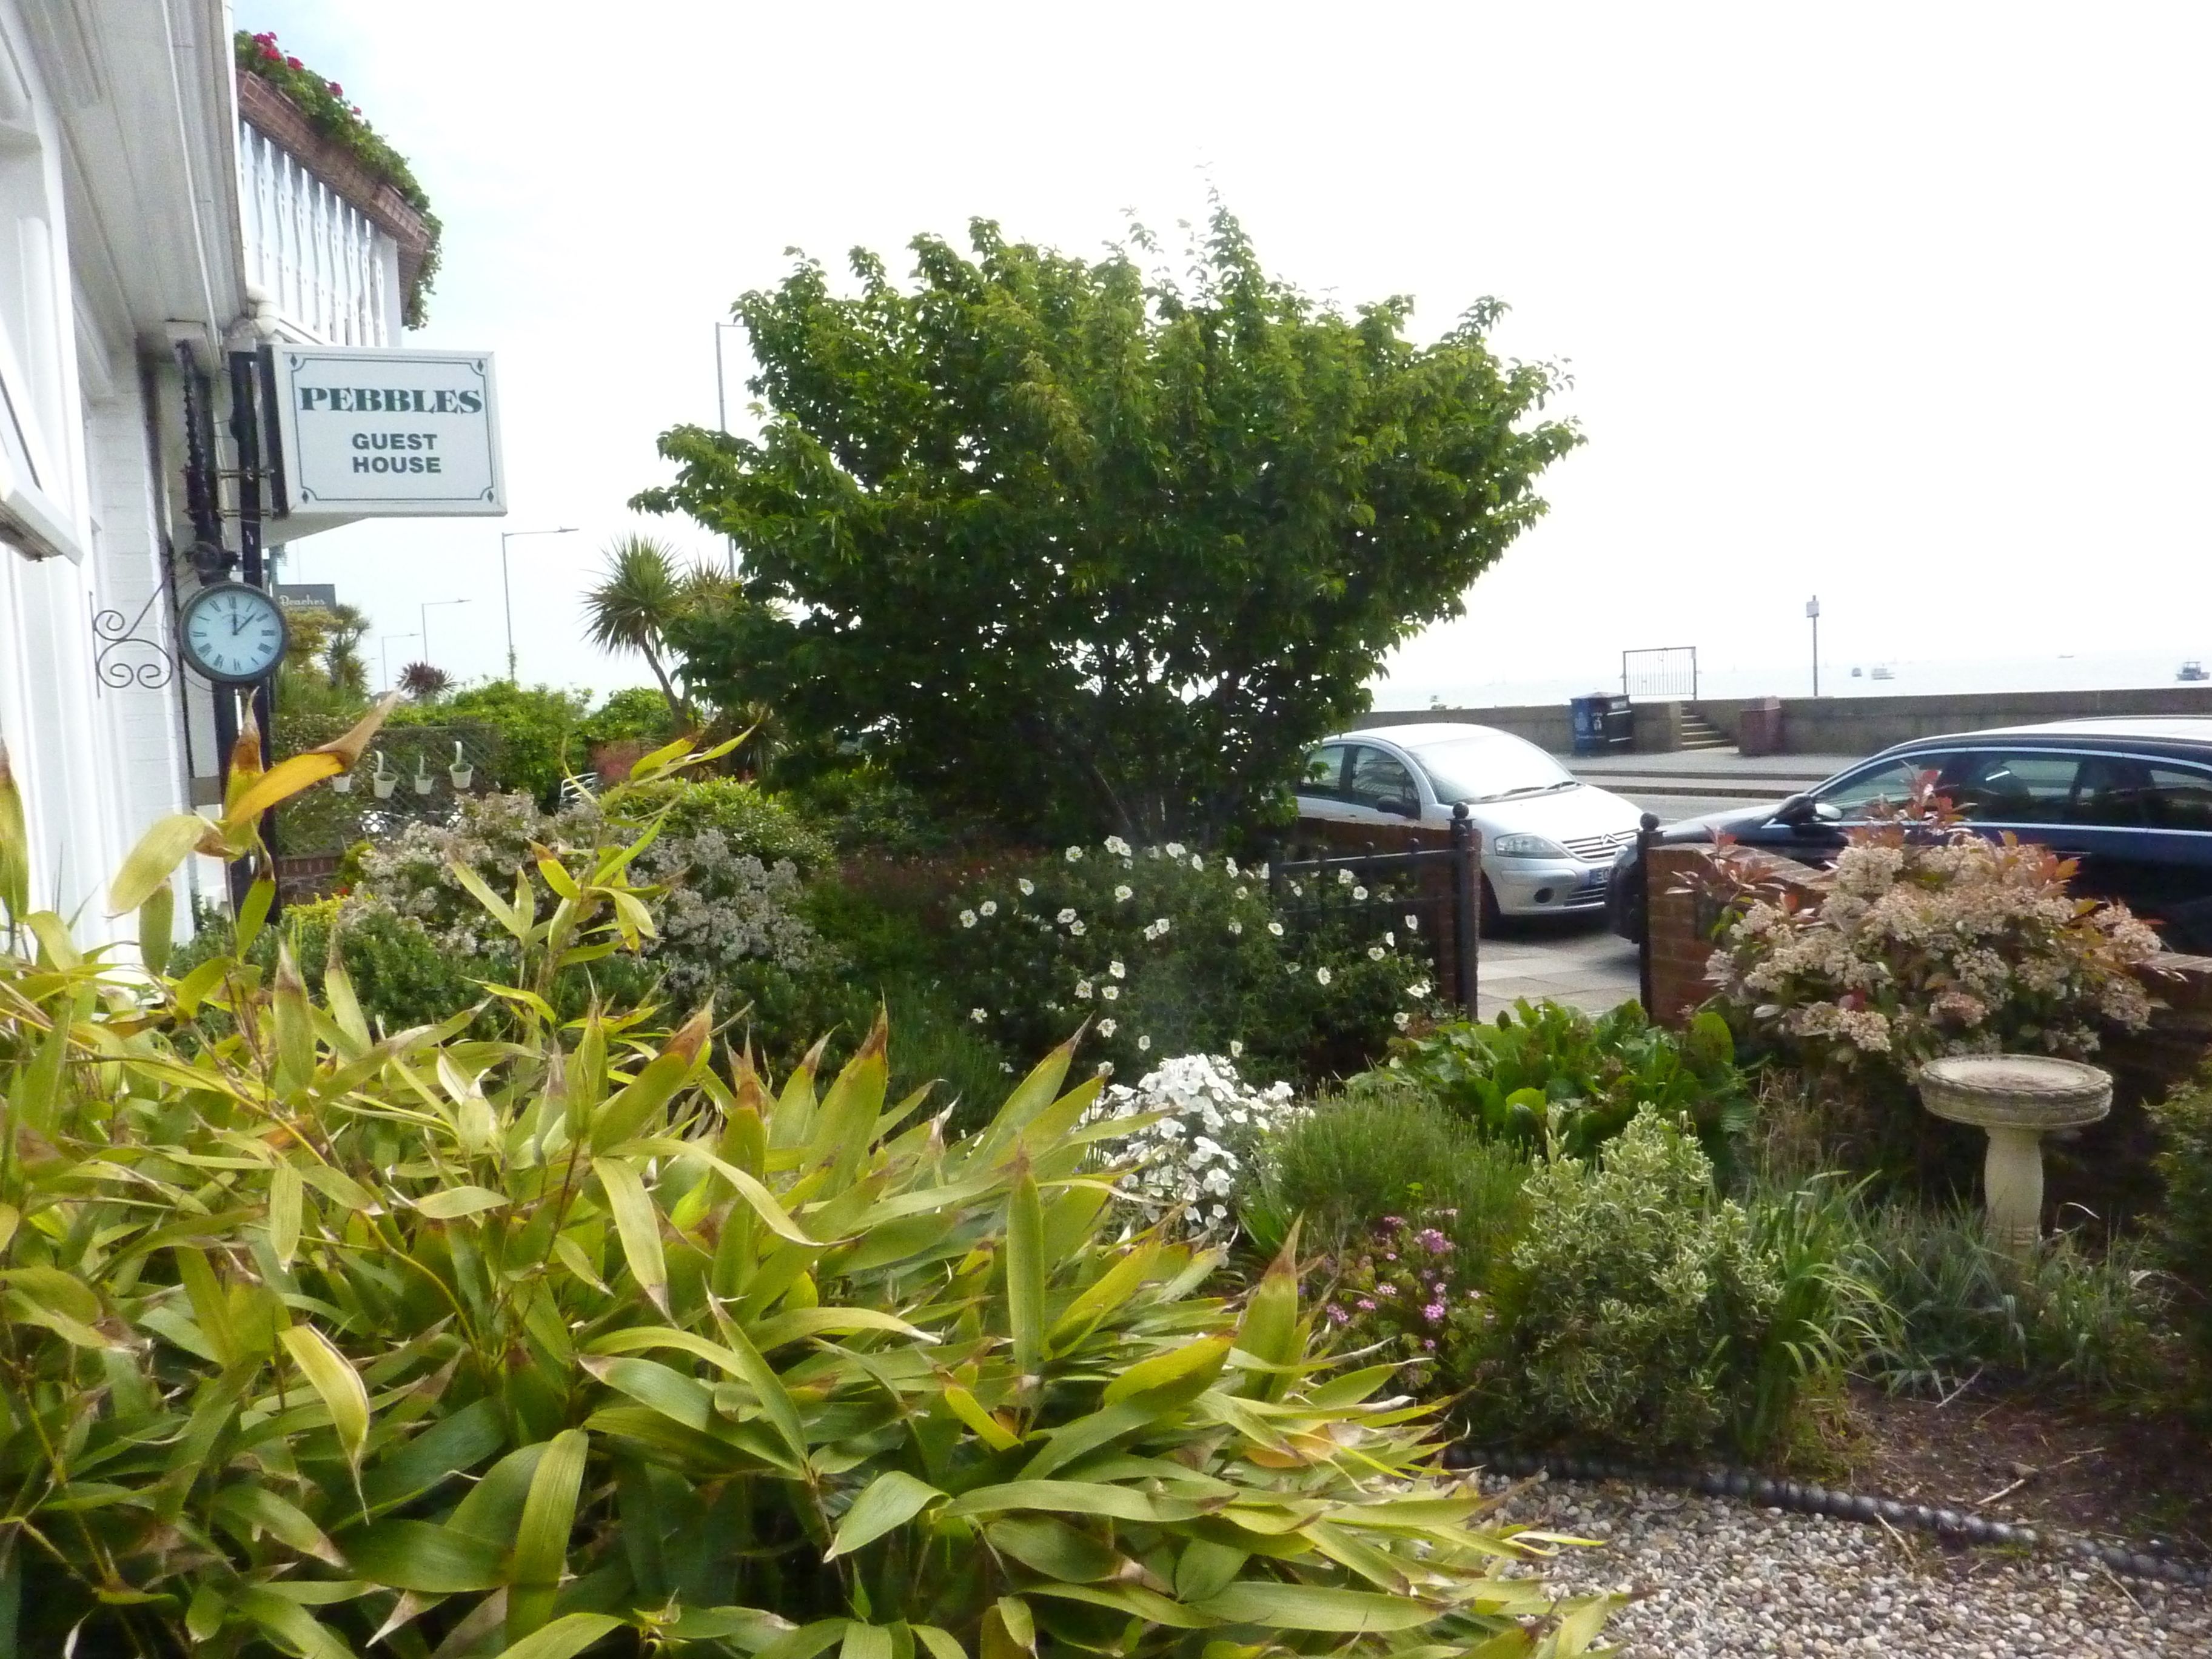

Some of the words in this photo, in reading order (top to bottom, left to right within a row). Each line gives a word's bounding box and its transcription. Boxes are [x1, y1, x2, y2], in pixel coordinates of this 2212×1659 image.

[298, 386, 483, 415] PEBBLES
[352, 433, 438, 451] GUEST
[352, 457, 442, 474] HOUSE
[279, 594, 326, 606] Beaches
